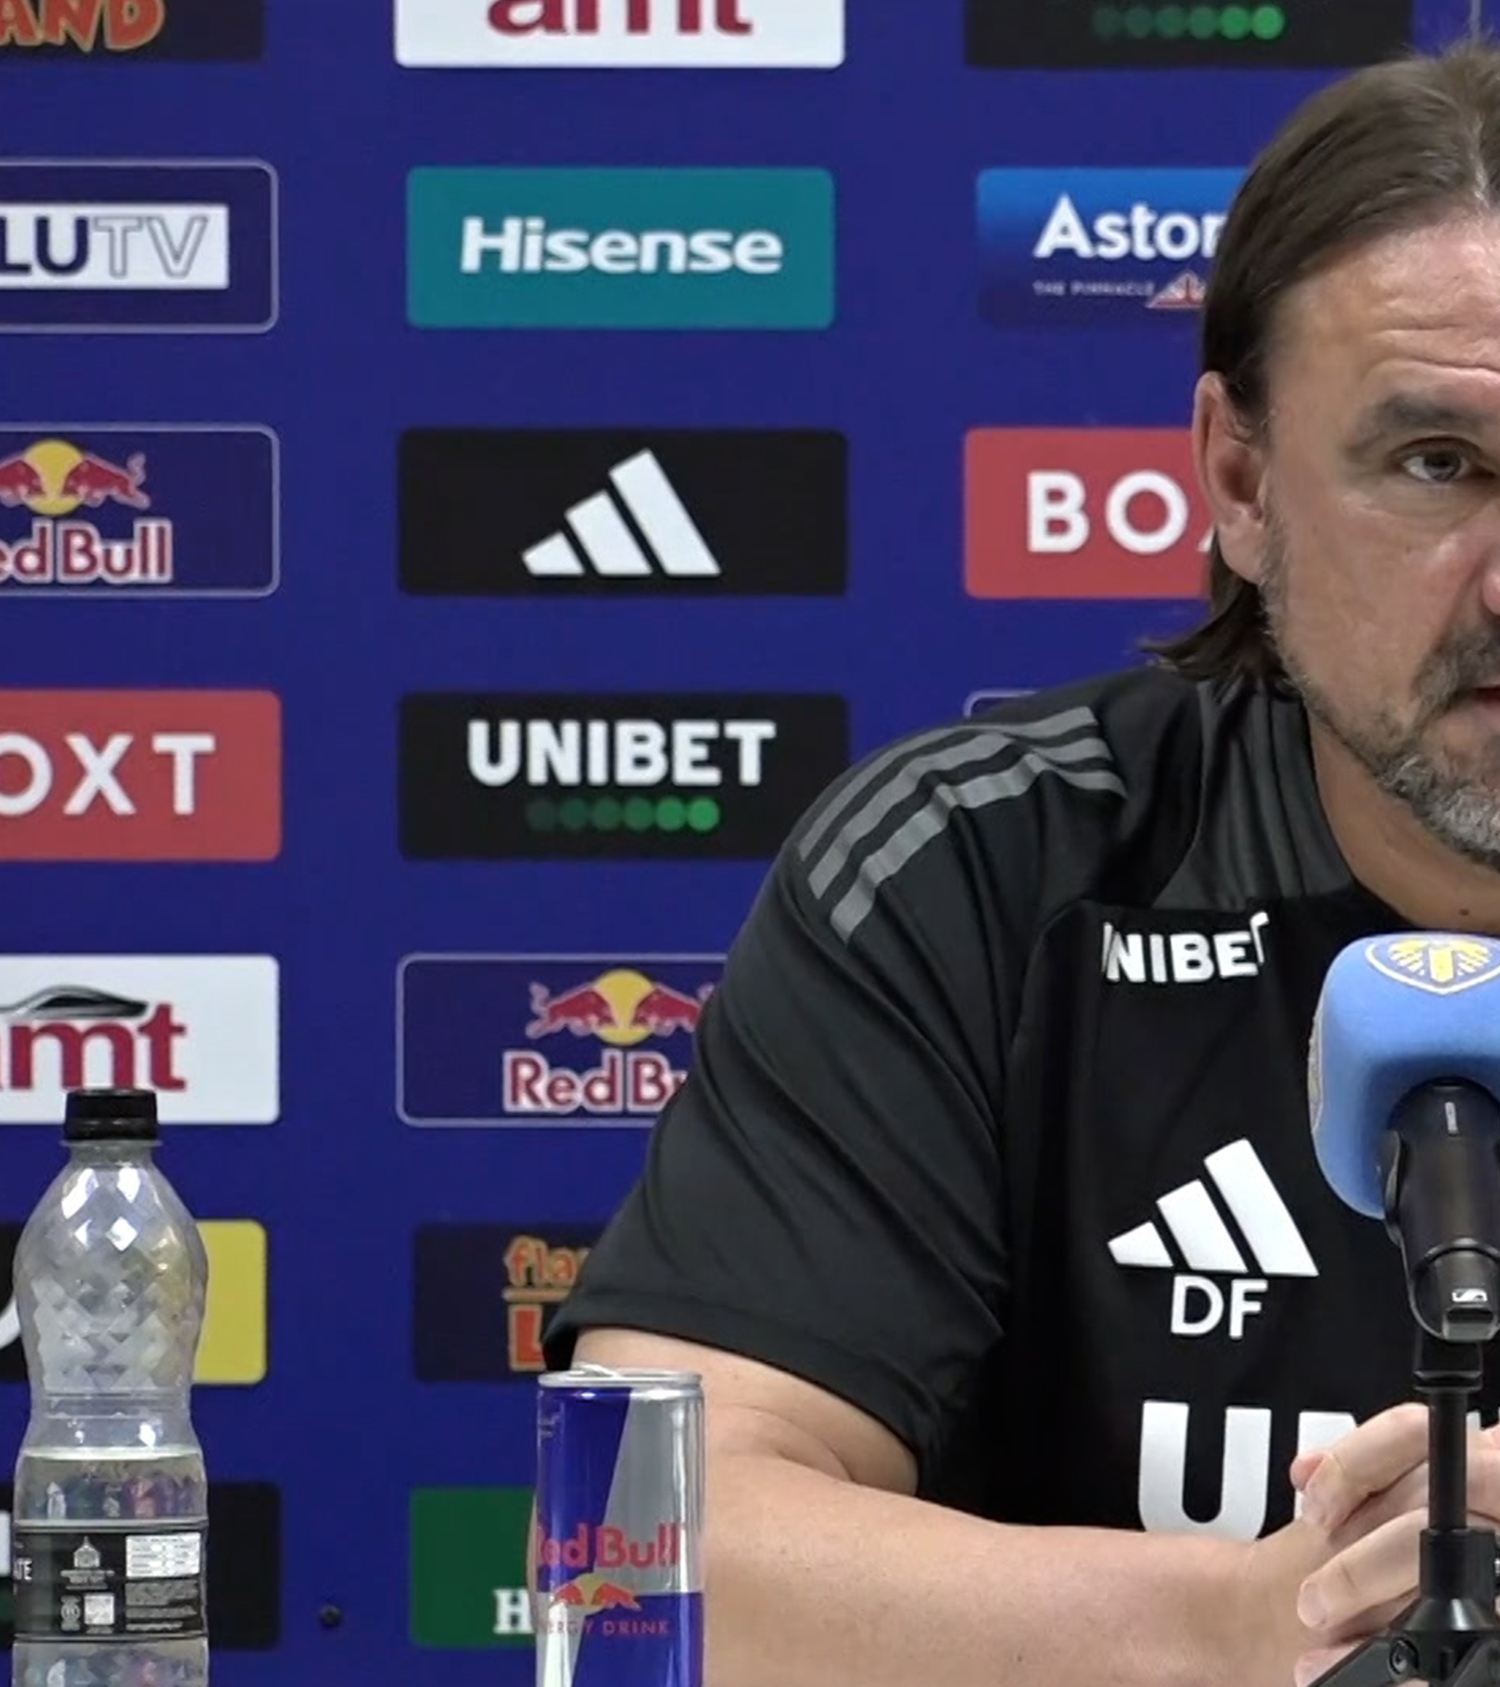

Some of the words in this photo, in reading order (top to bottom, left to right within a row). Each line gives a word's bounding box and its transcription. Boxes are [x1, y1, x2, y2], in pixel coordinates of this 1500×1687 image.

[459, 216, 783, 274] Hisense
[1027, 470, 1215, 554] BO
[57, 518, 172, 583] Bull
[466, 719, 778, 787] UNIBET
[0, 1002, 187, 1090] mt
[503, 1049, 624, 1114] Red
[1170, 1274, 1269, 1340] DF
[597, 1522, 679, 1569] Bull
[602, 1620, 670, 1635] DRINK
